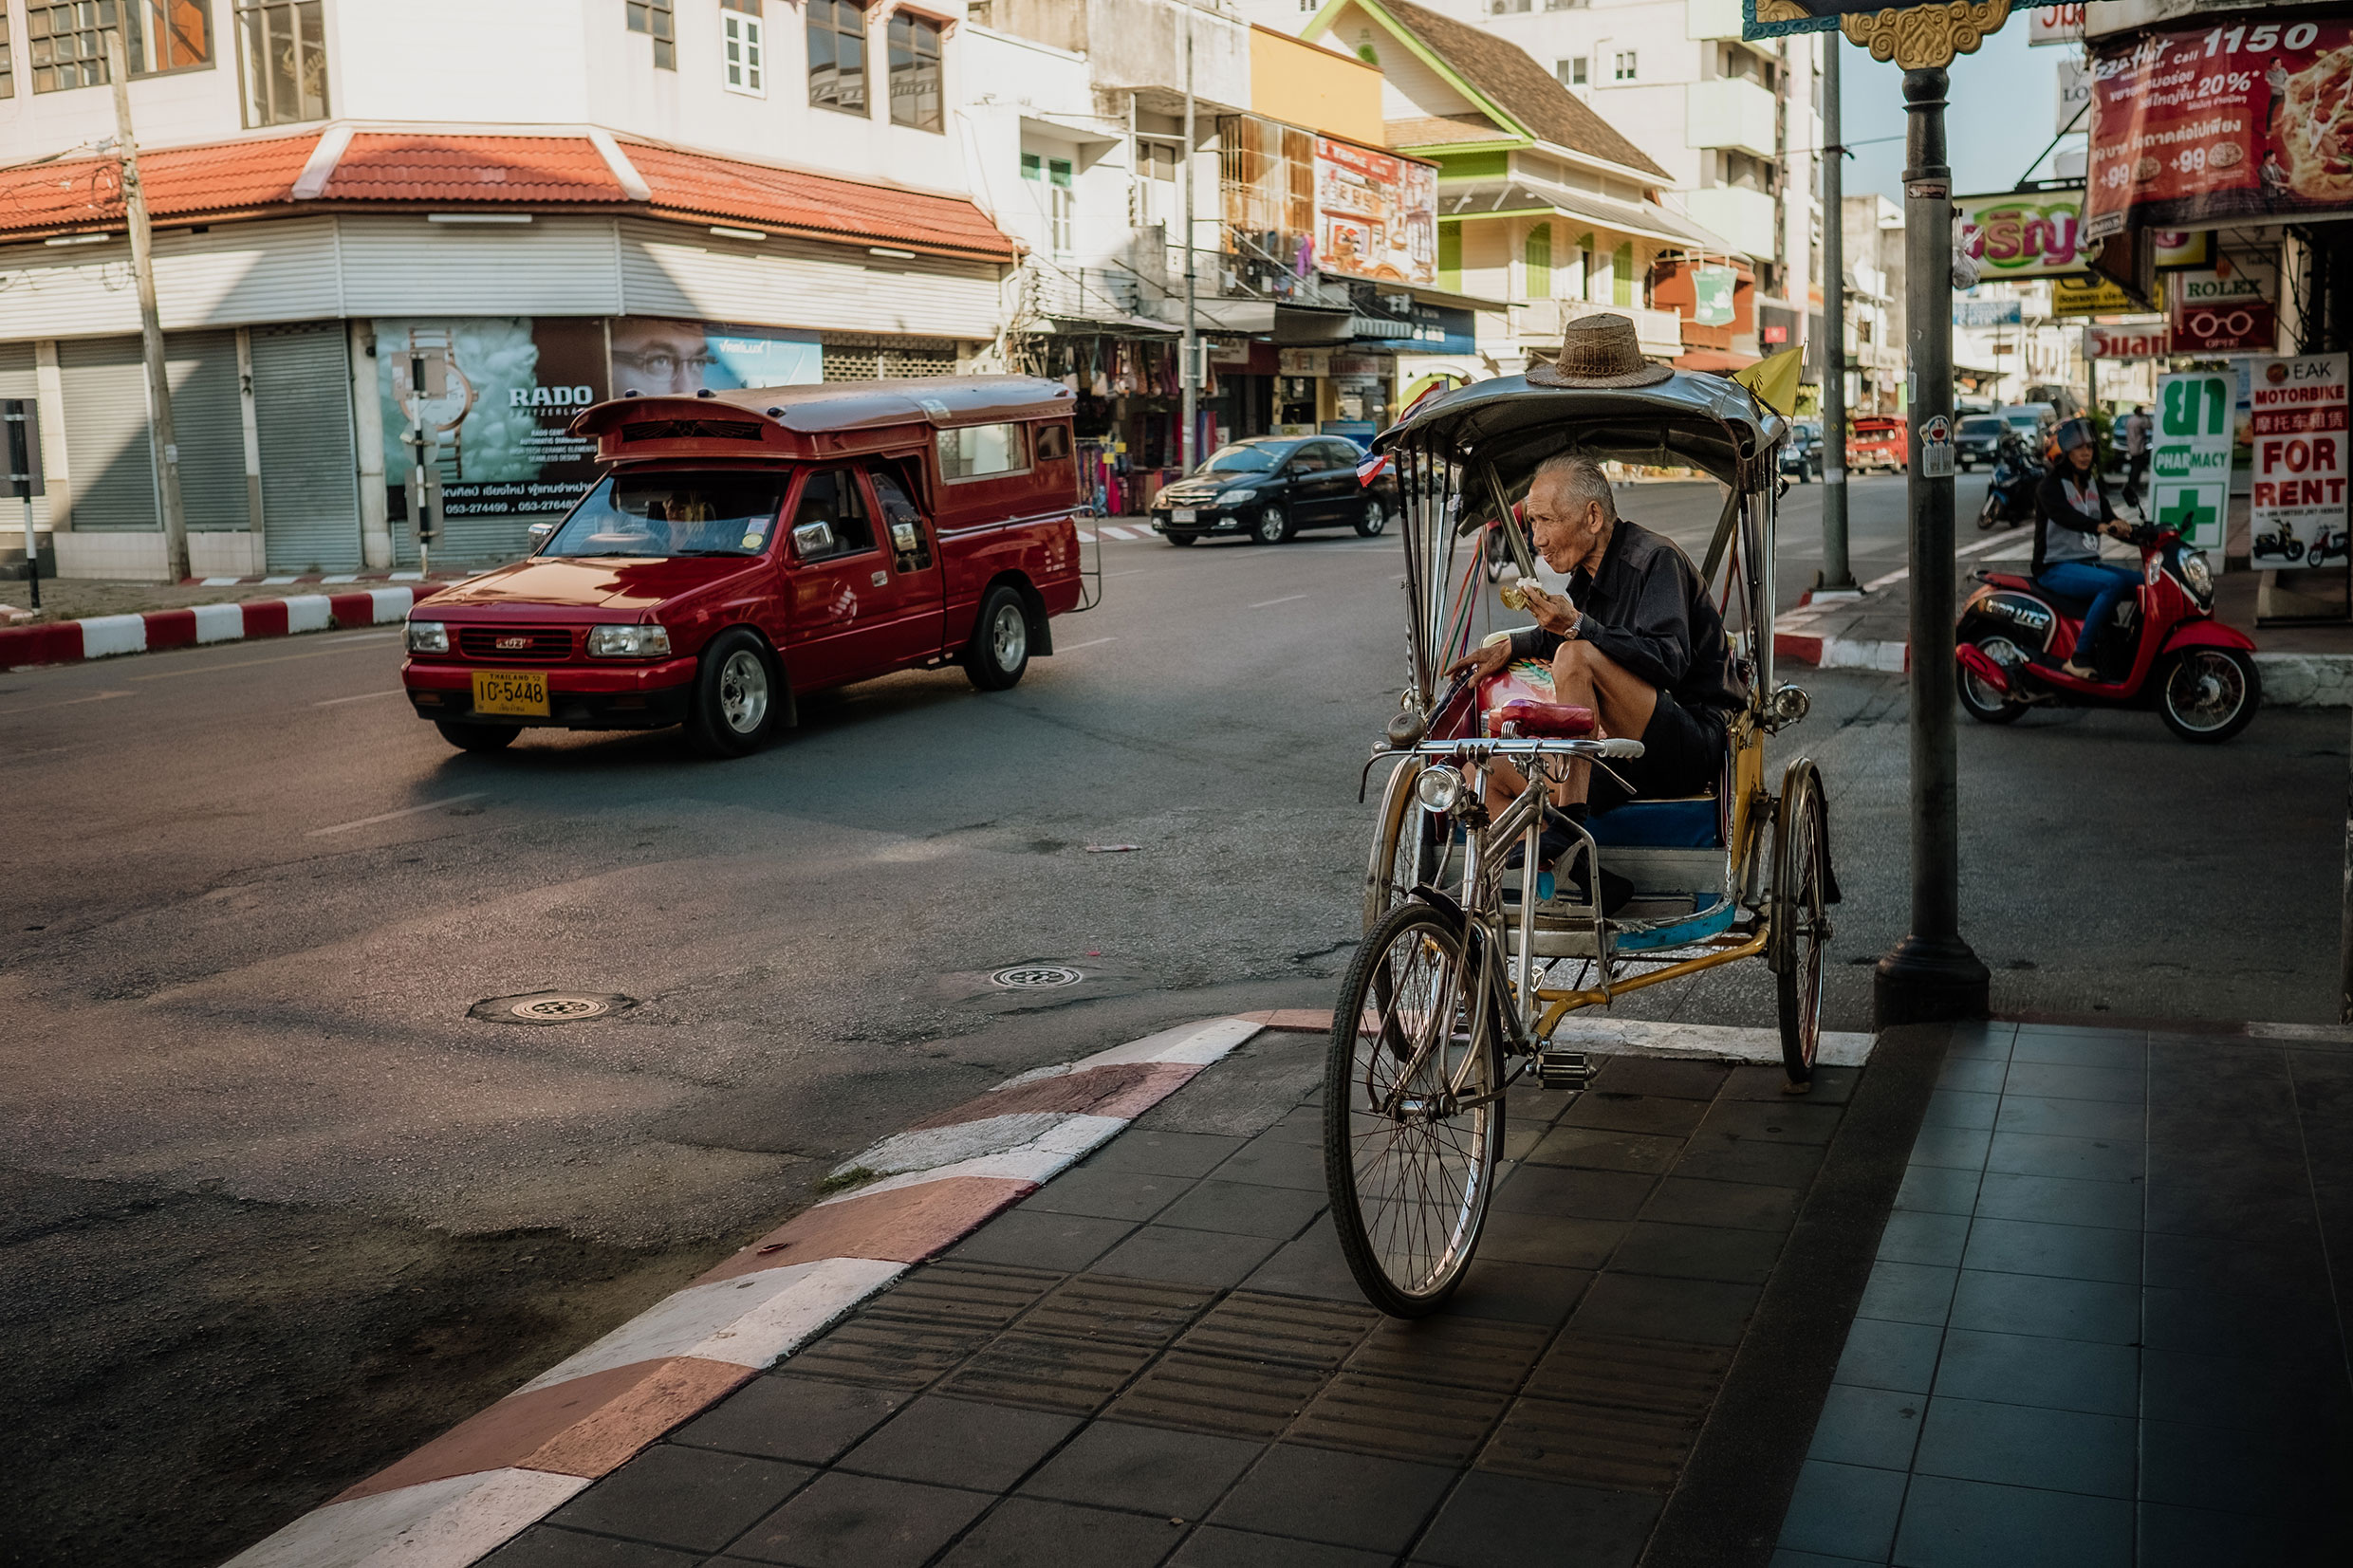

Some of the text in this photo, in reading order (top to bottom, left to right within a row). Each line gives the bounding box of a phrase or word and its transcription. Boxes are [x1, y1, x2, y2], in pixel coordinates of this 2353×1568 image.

[2173, 23, 2319, 65] Call 1150
[2170, 147, 2206, 174] +99
[2188, 279, 2262, 297] ROLEX
[2294, 361, 2331, 380] EAK
[509, 385, 593, 407] RADO
[2255, 384, 2345, 406] MOTORBIKE
[509, 407, 578, 418] SWITZERLA
[2163, 378, 2227, 436] ยา
[2156, 452, 2228, 470] PHARMACY
[2263, 438, 2337, 474] FOR
[2254, 478, 2346, 507] RENT
[446, 503, 509, 515] 053-274499
